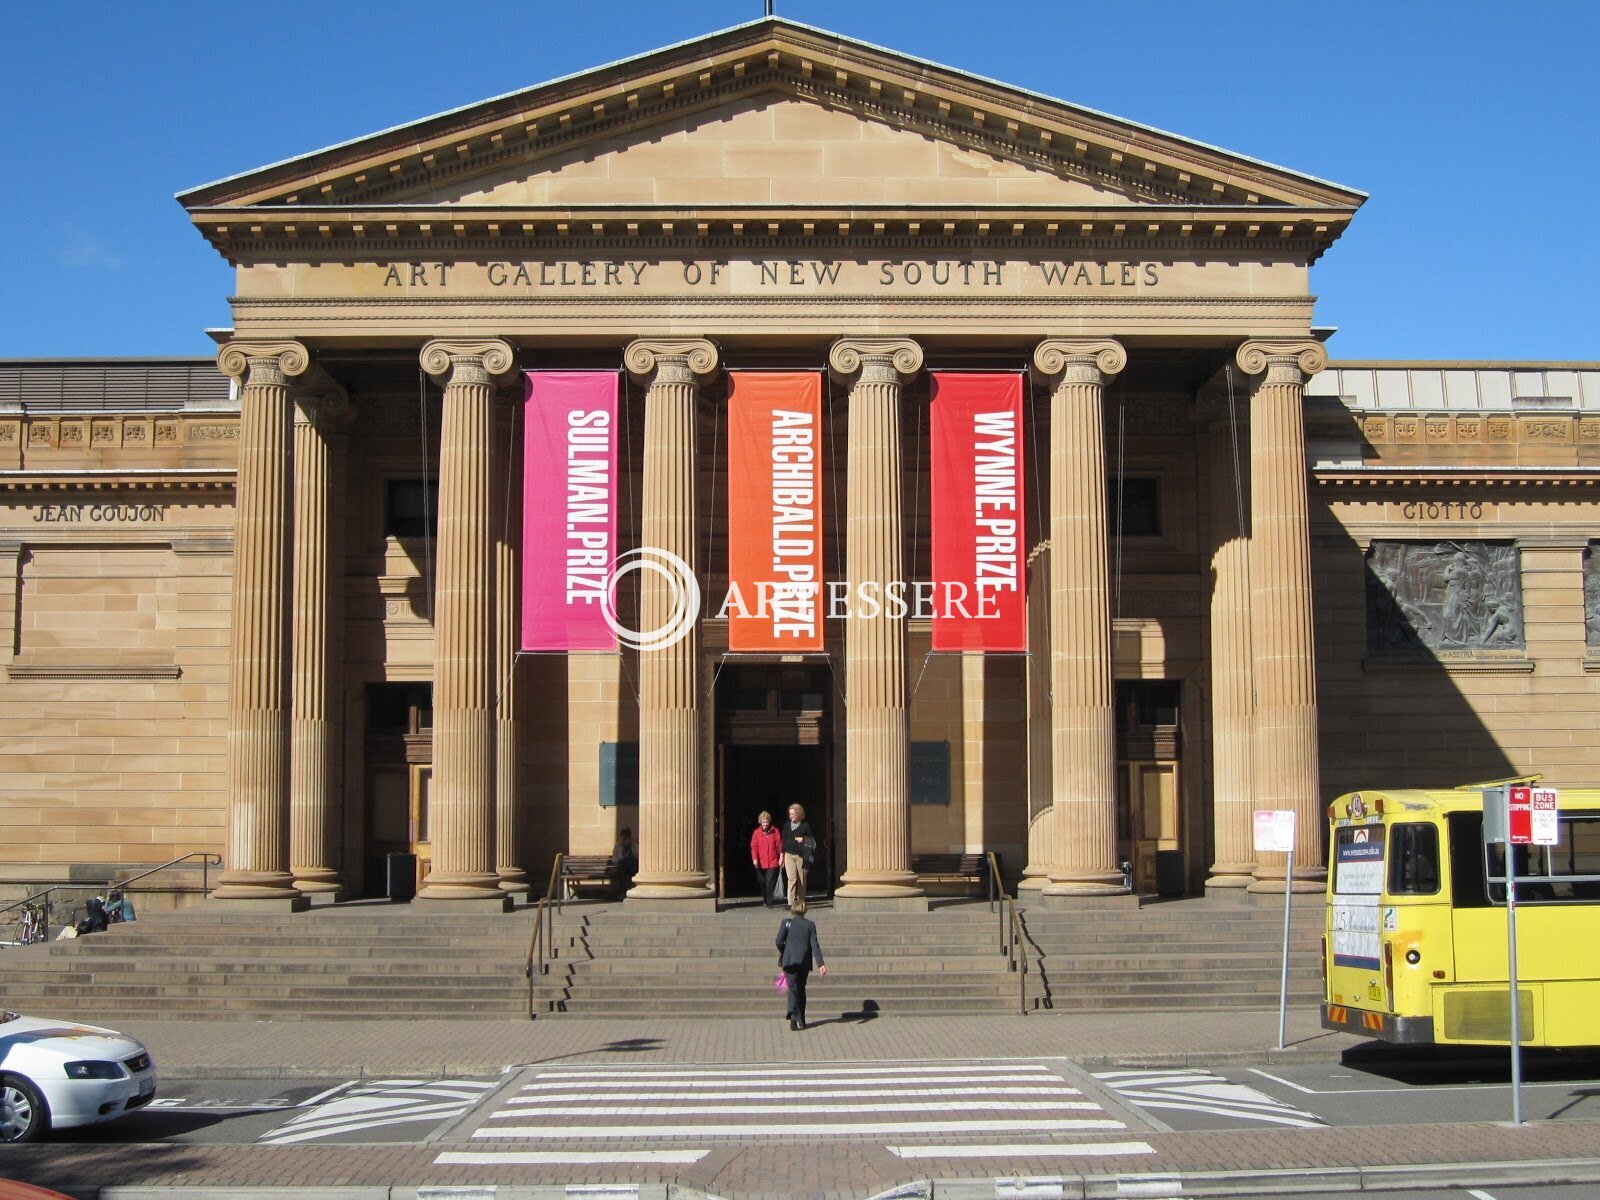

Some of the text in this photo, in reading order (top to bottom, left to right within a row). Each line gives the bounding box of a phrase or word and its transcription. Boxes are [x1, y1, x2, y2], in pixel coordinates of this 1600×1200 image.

[384, 260, 1160, 287] ART GALLERY OF NEW SOUTH WALES
[33, 505, 165, 522] JEAN GOUJON
[1403, 503, 1482, 520] GIOTTO
[1514, 792, 1524, 800] NO
[1535, 794, 1554, 802] BUS
[1534, 802, 1555, 810] ZONE
